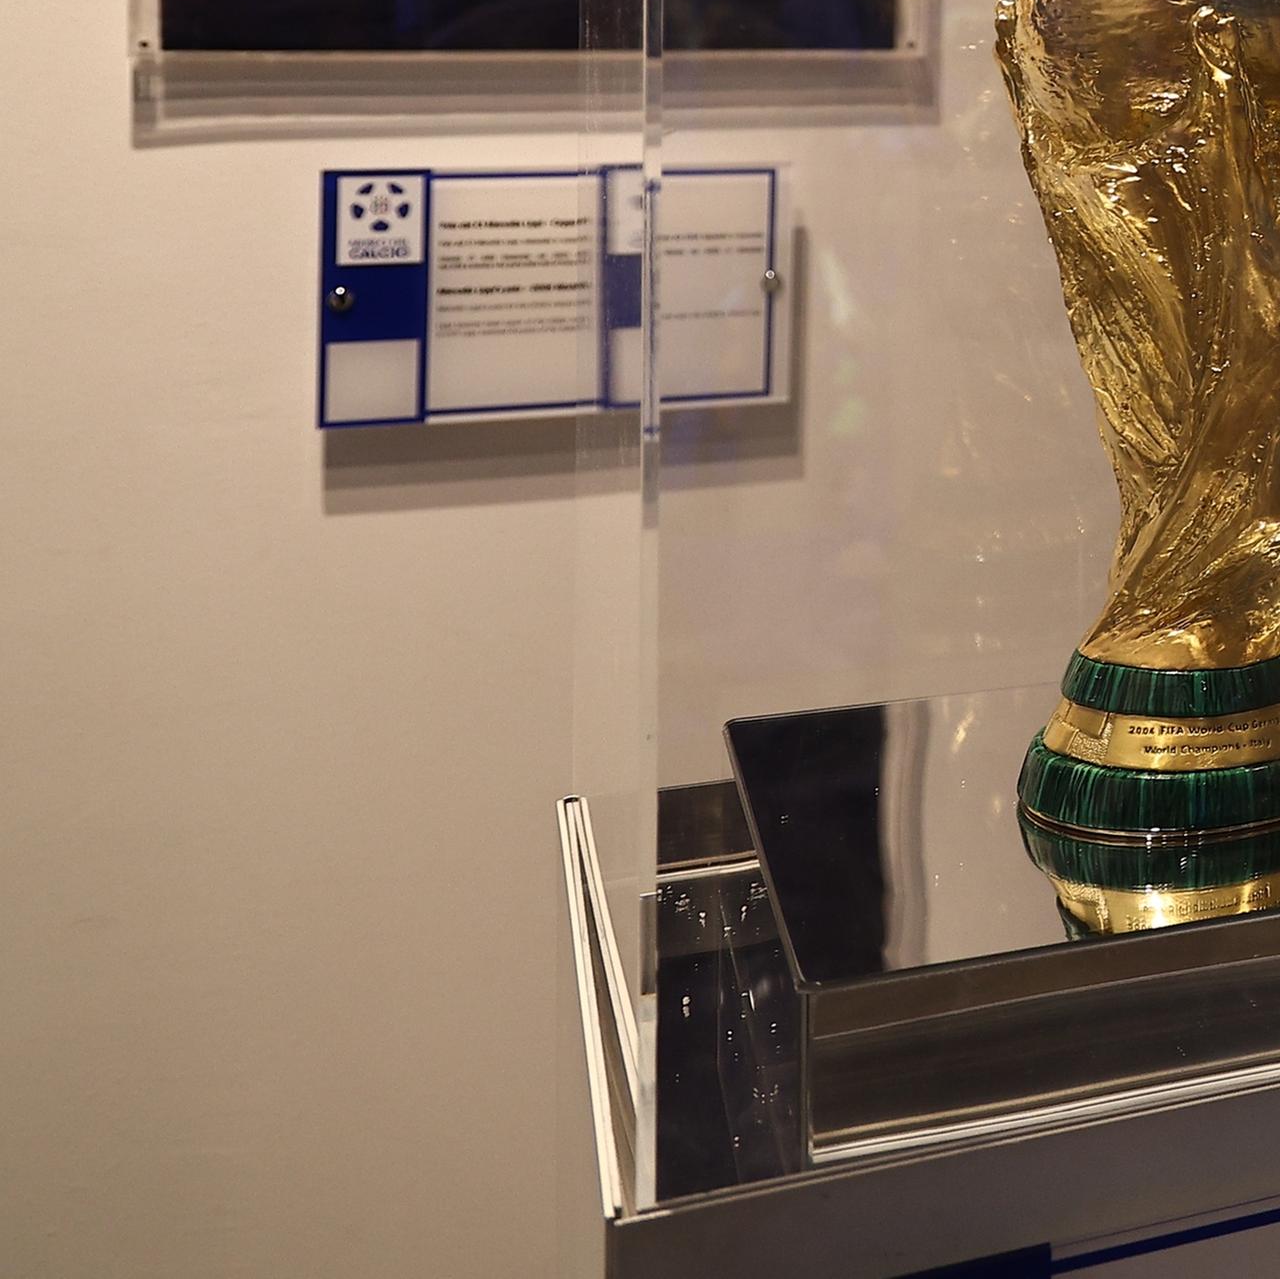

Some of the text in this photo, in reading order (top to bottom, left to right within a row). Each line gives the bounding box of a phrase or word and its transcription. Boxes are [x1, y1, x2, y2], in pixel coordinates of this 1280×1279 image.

[1159, 725, 1184, 735] FIFA
[1187, 724, 1223, 736] World
[1228, 722, 1249, 734] Cup
[1144, 745, 1177, 755] World
[1179, 742, 1240, 756] Champions
